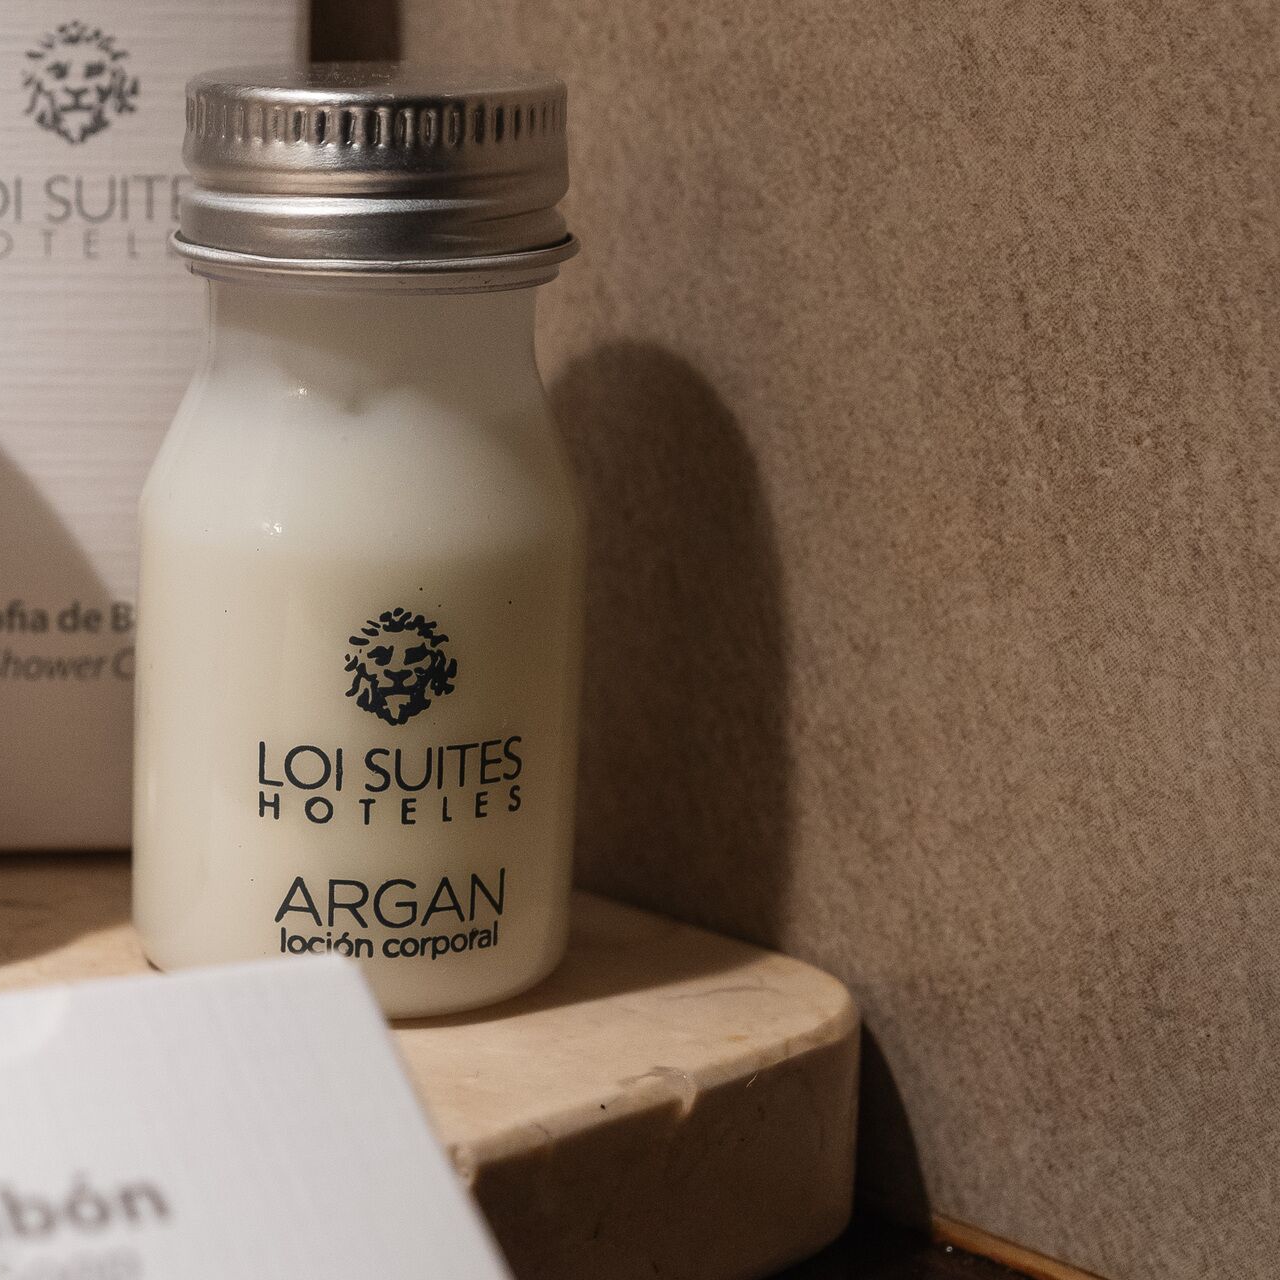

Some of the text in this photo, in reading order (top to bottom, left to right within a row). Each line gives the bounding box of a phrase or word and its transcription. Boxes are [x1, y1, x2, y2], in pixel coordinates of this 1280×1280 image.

[56, 599, 103, 634] de
[258, 735, 523, 793] LOI SUITES
[258, 785, 522, 825] HOTELES
[274, 867, 506, 929] ARGAN
[280, 920, 498, 960] loción corporal
